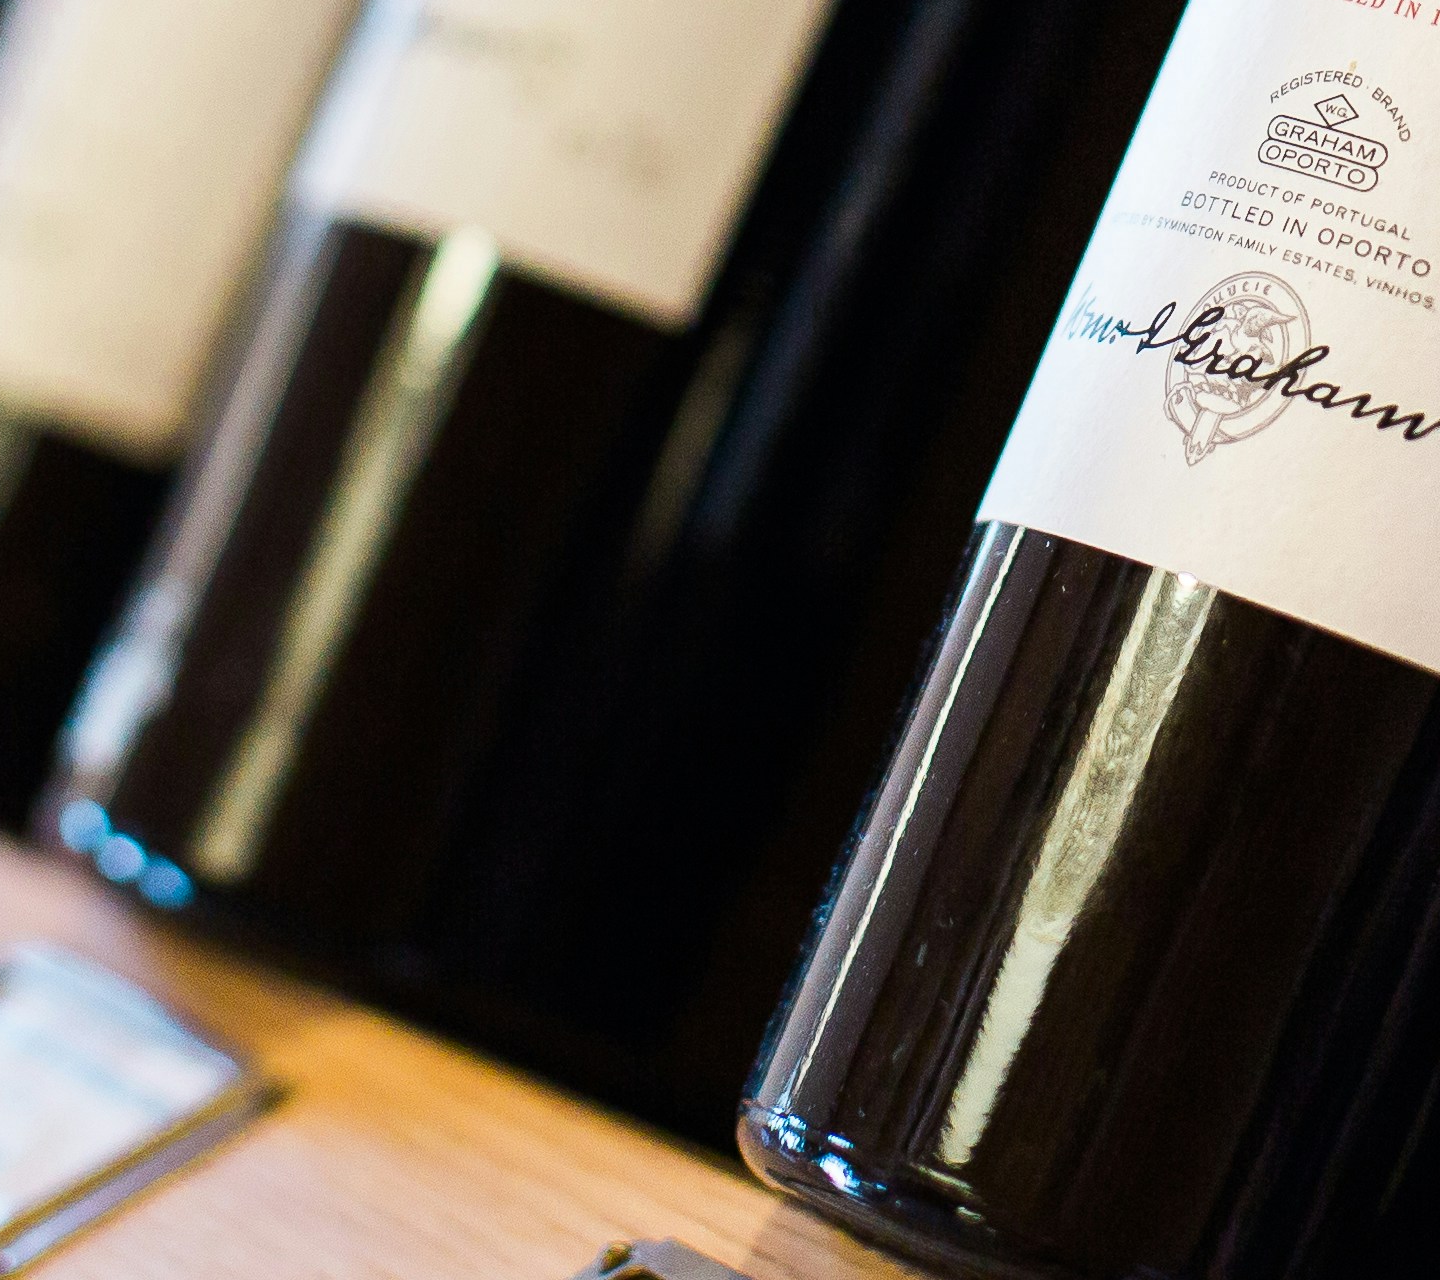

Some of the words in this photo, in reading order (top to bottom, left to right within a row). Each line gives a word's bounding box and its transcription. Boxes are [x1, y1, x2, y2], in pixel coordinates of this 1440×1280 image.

[1269, 69, 1364, 104] REGISTERED
[1371, 86, 1411, 142] BRAND
[1265, 144, 1366, 185] OPORTO
[1274, 120, 1377, 163] GRAHAM
[1180, 189, 1274, 228] BOTTLED
[1281, 215, 1309, 239] IN
[1316, 227, 1432, 278] OPORTO
[1208, 170, 1280, 199] PRODUCT
[1281, 189, 1306, 206] OF
[1310, 197, 1411, 241] PORTUGAL
[1156, 215, 1224, 244] SYMINGTON
[1226, 233, 1279, 257] FAMILY
[1281, 249, 1358, 286] ESTATES,
